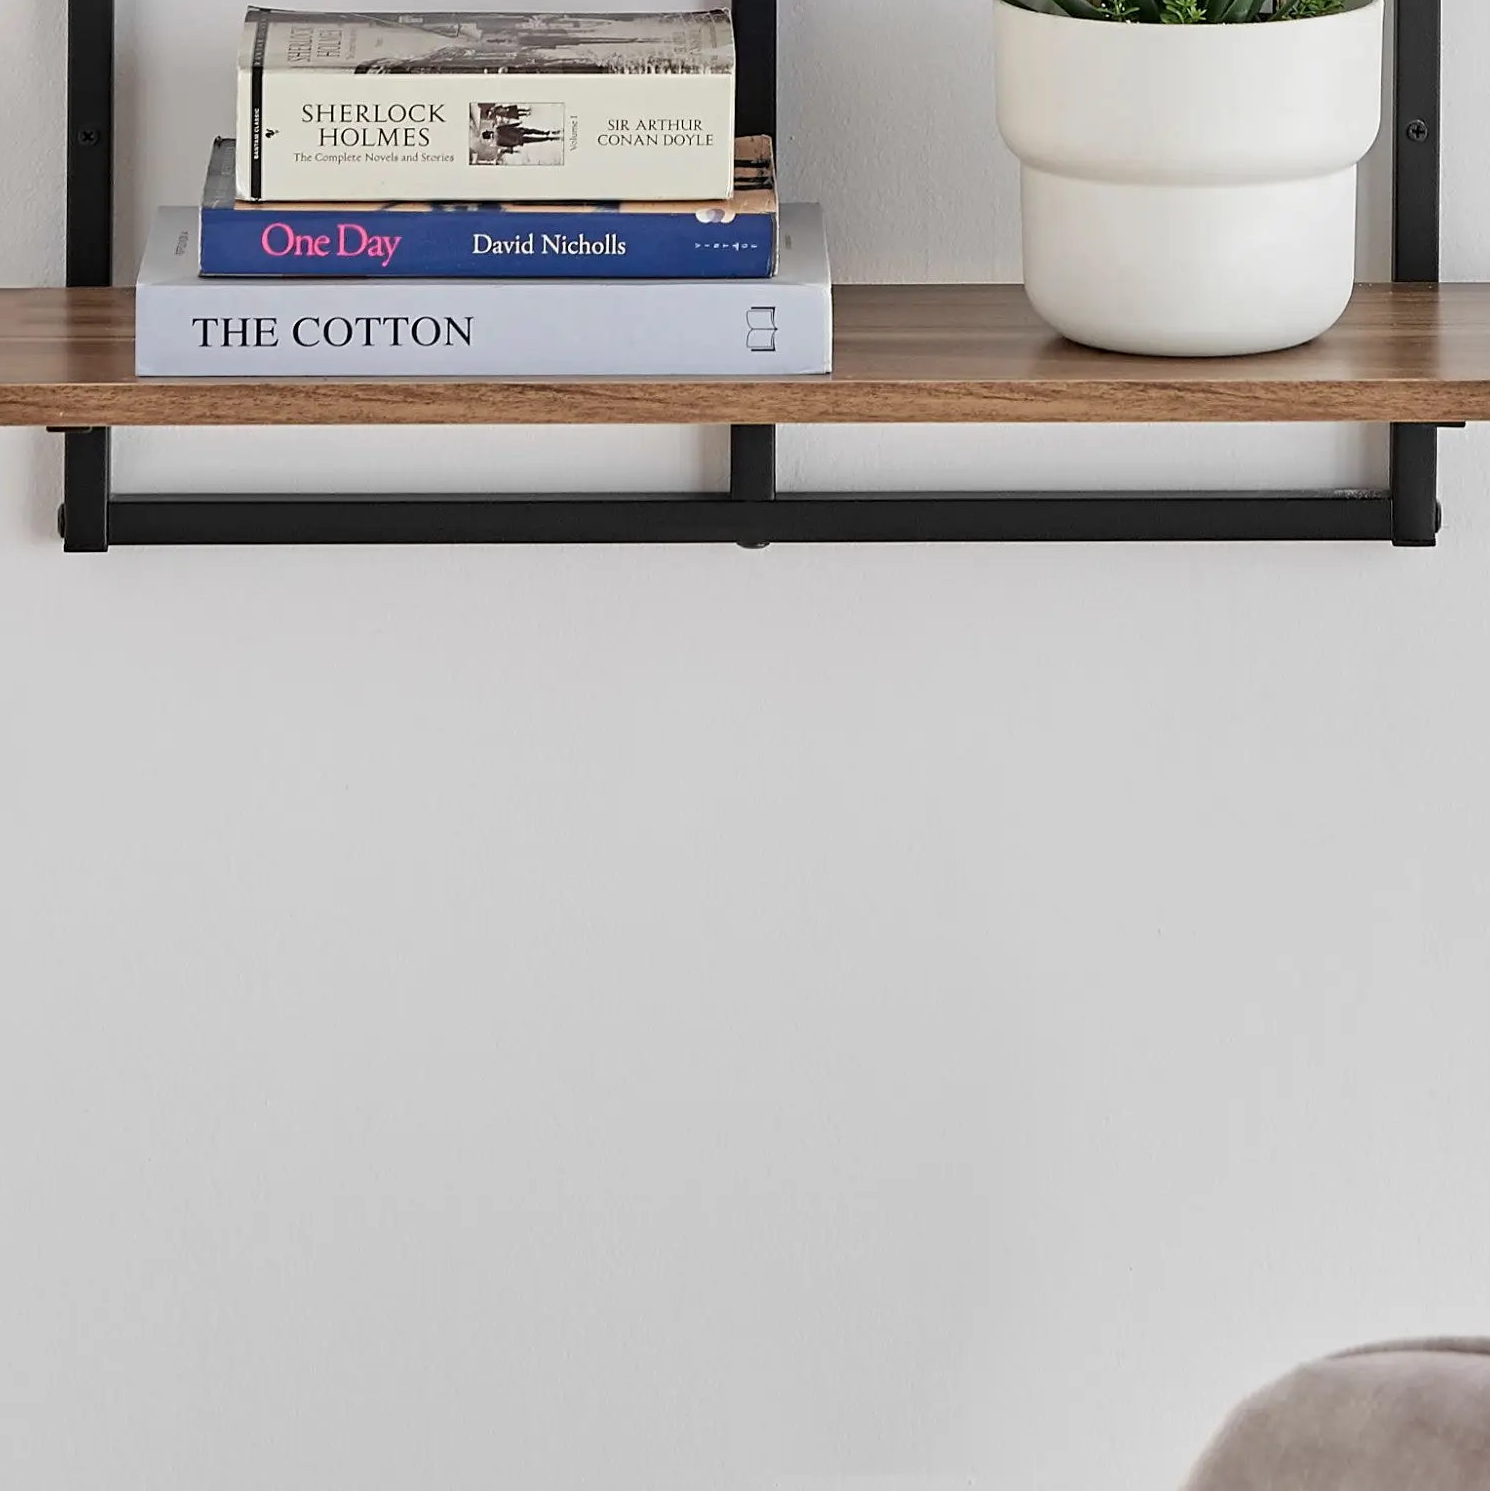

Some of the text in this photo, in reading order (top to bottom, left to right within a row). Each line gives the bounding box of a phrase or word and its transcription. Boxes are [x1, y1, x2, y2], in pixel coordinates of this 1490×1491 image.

[301, 103, 447, 123] SHERLOCK
[608, 119, 703, 131] SIR ARTHUR
[318, 127, 430, 147] HOLMES
[569, 120, 578, 152] Volume
[597, 134, 713, 146] CONAN DOYLE
[294, 152, 454, 165] The Complete Novels and Stories
[261, 222, 402, 267] One Day
[472, 233, 627, 256] David Nicholls
[192, 316, 474, 347] THE COTTON
